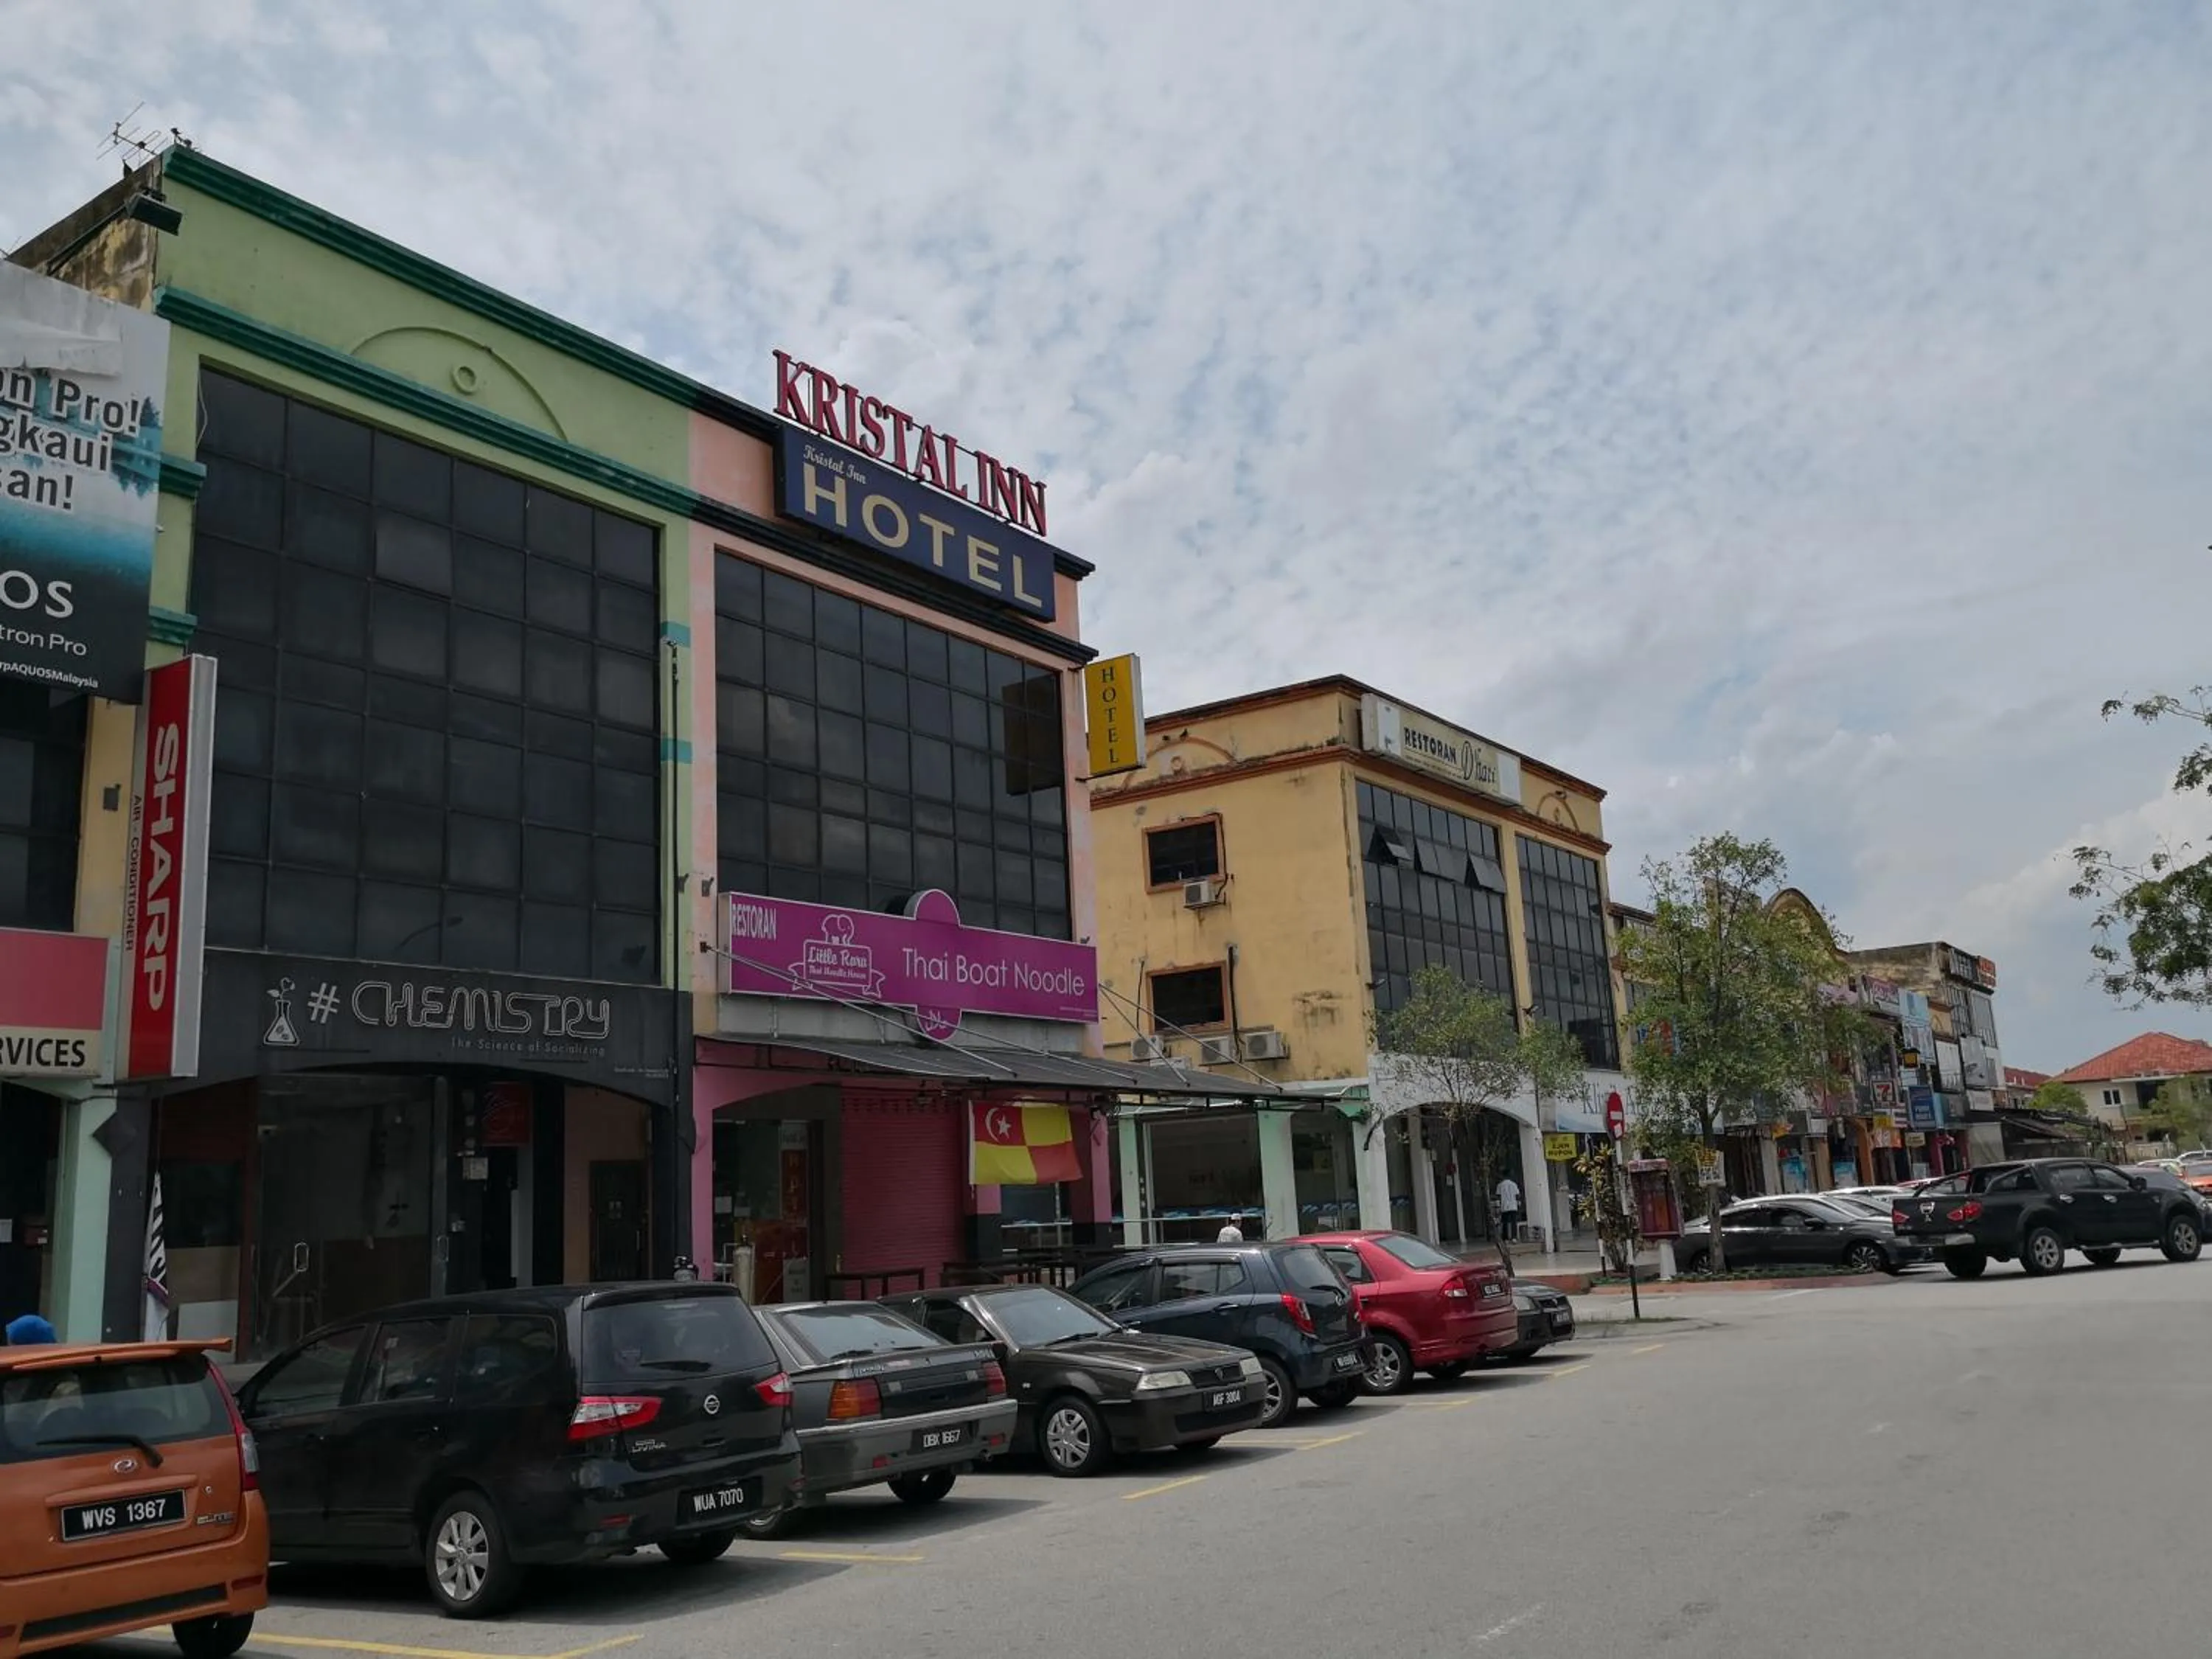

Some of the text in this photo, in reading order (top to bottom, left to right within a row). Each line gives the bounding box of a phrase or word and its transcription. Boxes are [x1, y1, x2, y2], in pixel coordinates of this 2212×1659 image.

[0, 370, 139, 433] n Pro!
[773, 349, 1047, 537] KRISTAL INN
[803, 444, 866, 484] Kristal Inn
[0, 469, 73, 510] an!
[803, 462, 1043, 608] HOTEL
[0, 570, 74, 618] OS
[49, 633, 87, 655] Pro
[1102, 666, 1119, 763] HOTEL
[1403, 726, 1457, 765] RESTORAN
[132, 794, 142, 822] AIR
[143, 722, 179, 1012] SHARP
[125, 836, 140, 951] CONDITIONER
[732, 903, 777, 941] RESTORAN
[902, 947, 1085, 996] Thai Boat Noodle
[451, 1036, 471, 1049] The
[479, 1037, 523, 1052] Science
[544, 1040, 606, 1057] Socializing
[82, 1498, 166, 1531] WVS 1367
[694, 1487, 744, 1513] WUA 7070
